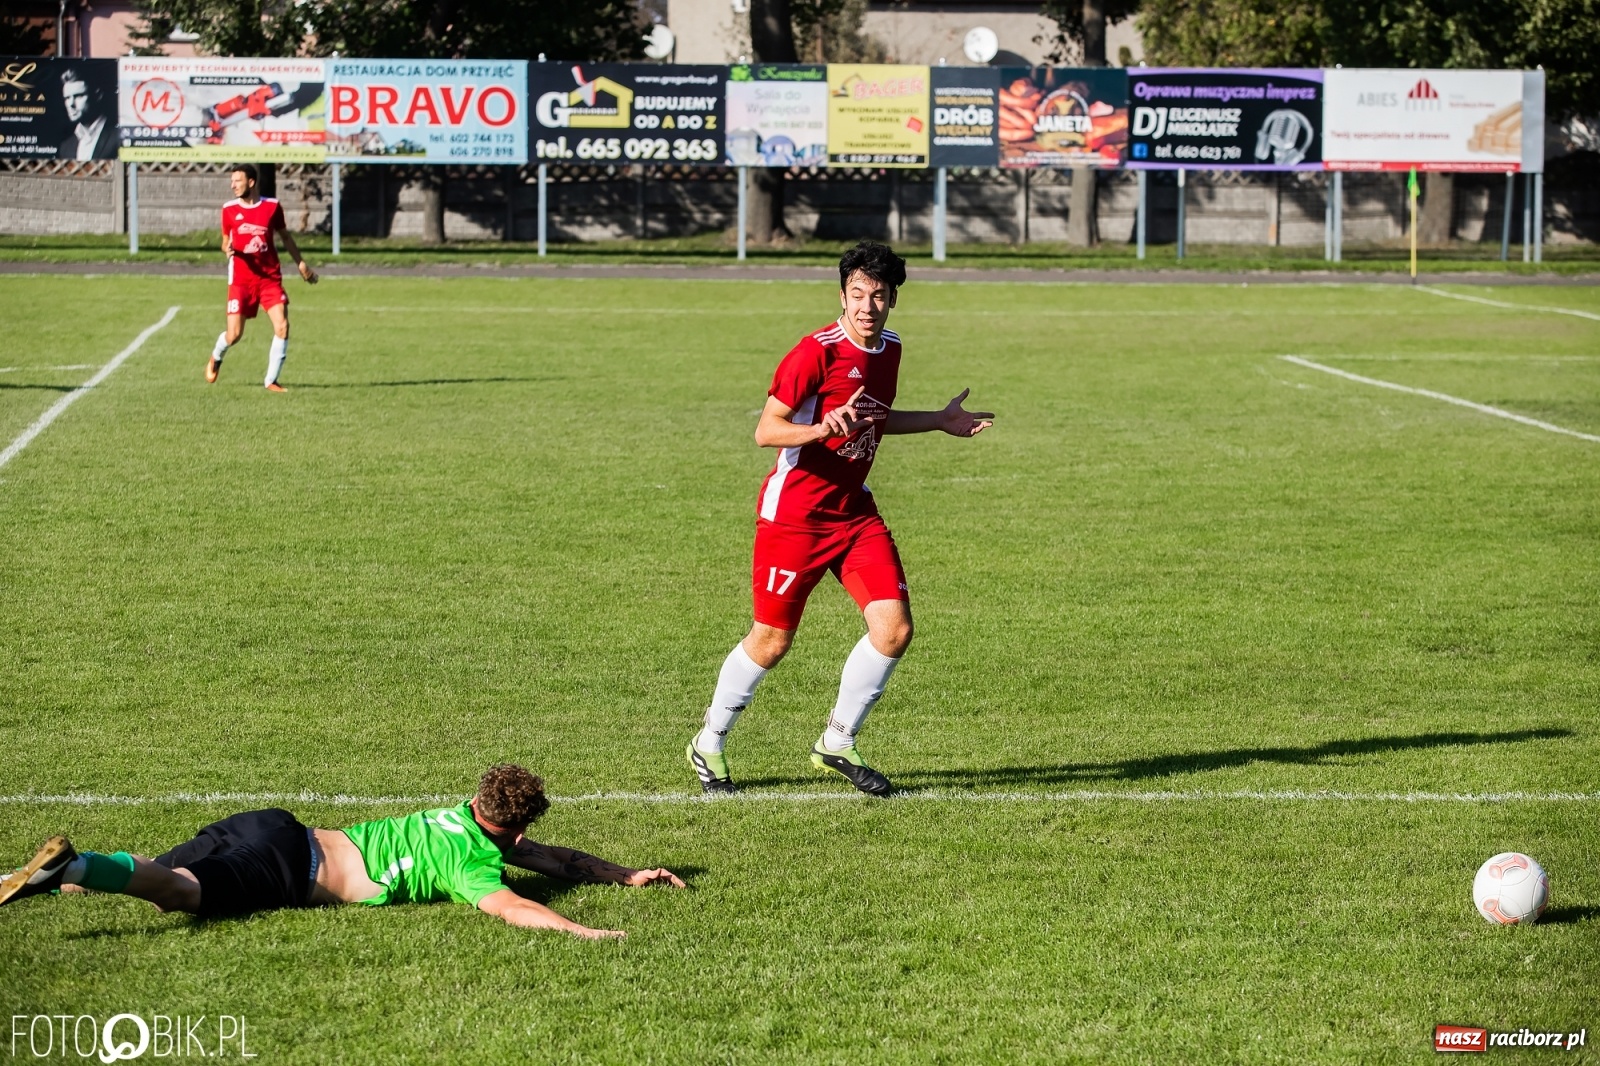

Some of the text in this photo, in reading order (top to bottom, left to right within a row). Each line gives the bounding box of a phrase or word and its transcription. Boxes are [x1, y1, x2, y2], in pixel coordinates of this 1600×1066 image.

[333, 64, 515, 78] RESTAURACJA DOM PRZYJĘĆ
[754, 87, 802, 101] Sala do
[854, 78, 925, 99] BAGER
[1134, 82, 1317, 102] Oprawa muzyczna imprez
[141, 91, 176, 112] ML
[330, 86, 517, 126] BRAVO
[634, 96, 717, 111] BUDUJEMY
[1357, 92, 1398, 107] ABIES
[634, 115, 717, 130] OD A DO Z
[934, 104, 994, 125] DRÓB
[1033, 115, 1093, 132] JANETA
[1132, 107, 1242, 139] DJ EUGENIUSZ
[430, 133, 446, 143] tel.
[536, 136, 718, 160] tel. 665 092 363
[766, 566, 798, 596] 17
